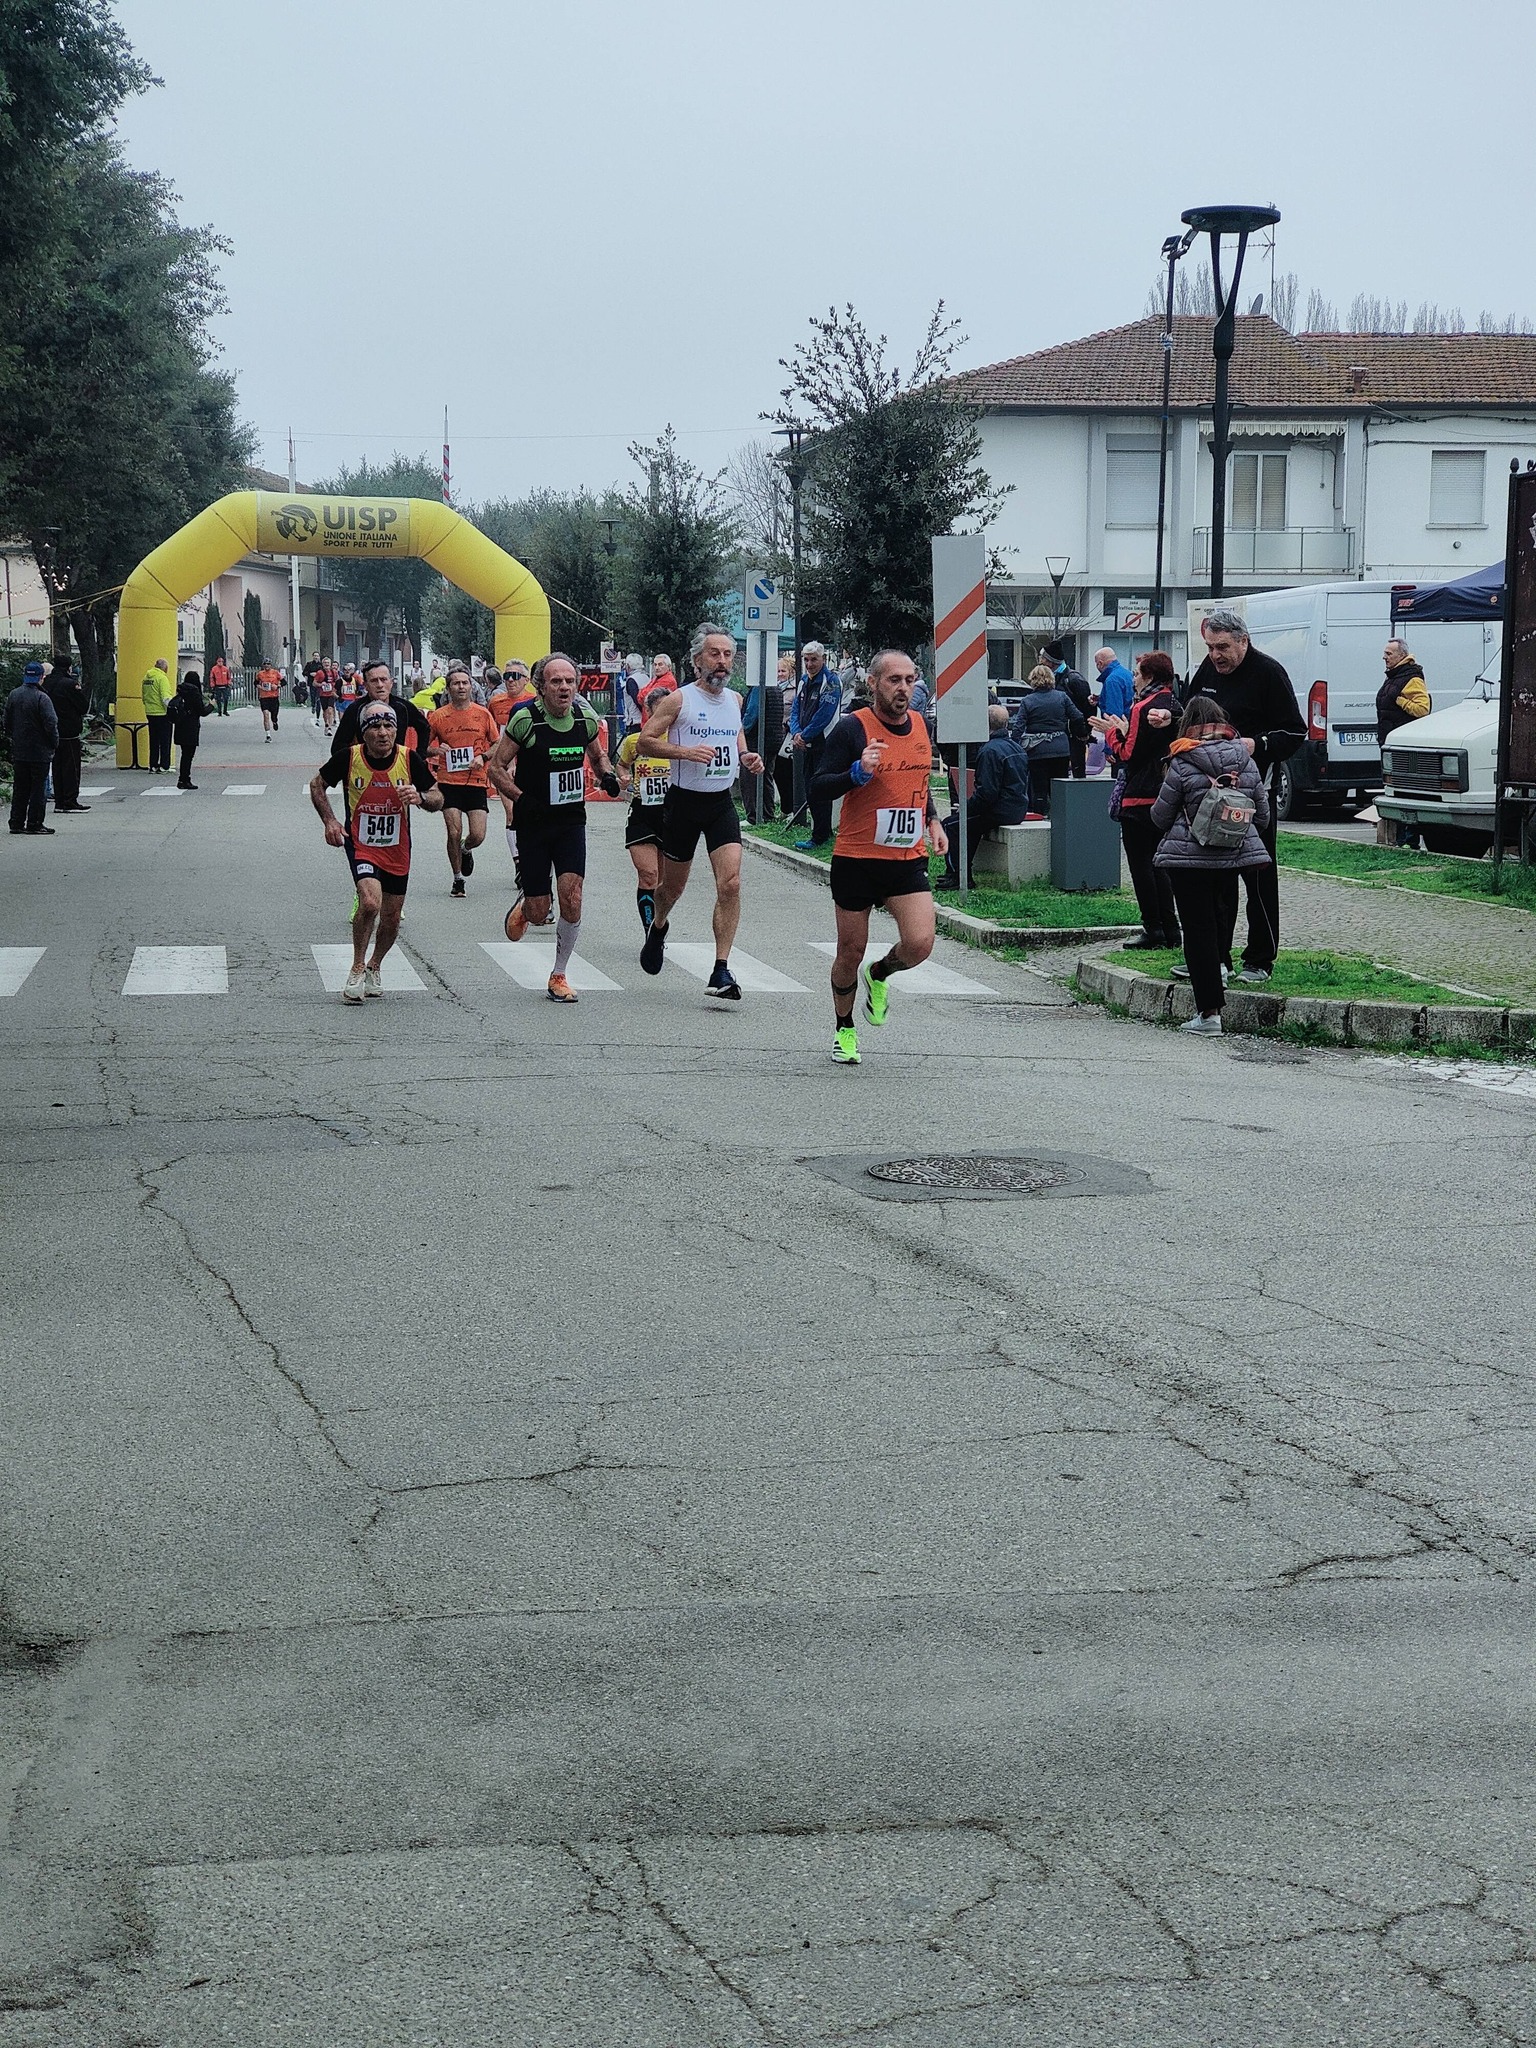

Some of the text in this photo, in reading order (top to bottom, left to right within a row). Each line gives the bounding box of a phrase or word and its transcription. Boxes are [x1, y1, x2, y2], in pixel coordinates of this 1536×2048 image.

[322, 505, 397, 531] UISP
[323, 531, 398, 541] UNIONE ITALIANA
[371, 541, 393, 549] TUTTI
[450, 748, 470, 764] 644
[707, 746, 731, 767] 93
[558, 769, 582, 793] 800
[646, 768, 668, 796] 655
[367, 815, 395, 836] 548
[887, 809, 916, 834] 705
